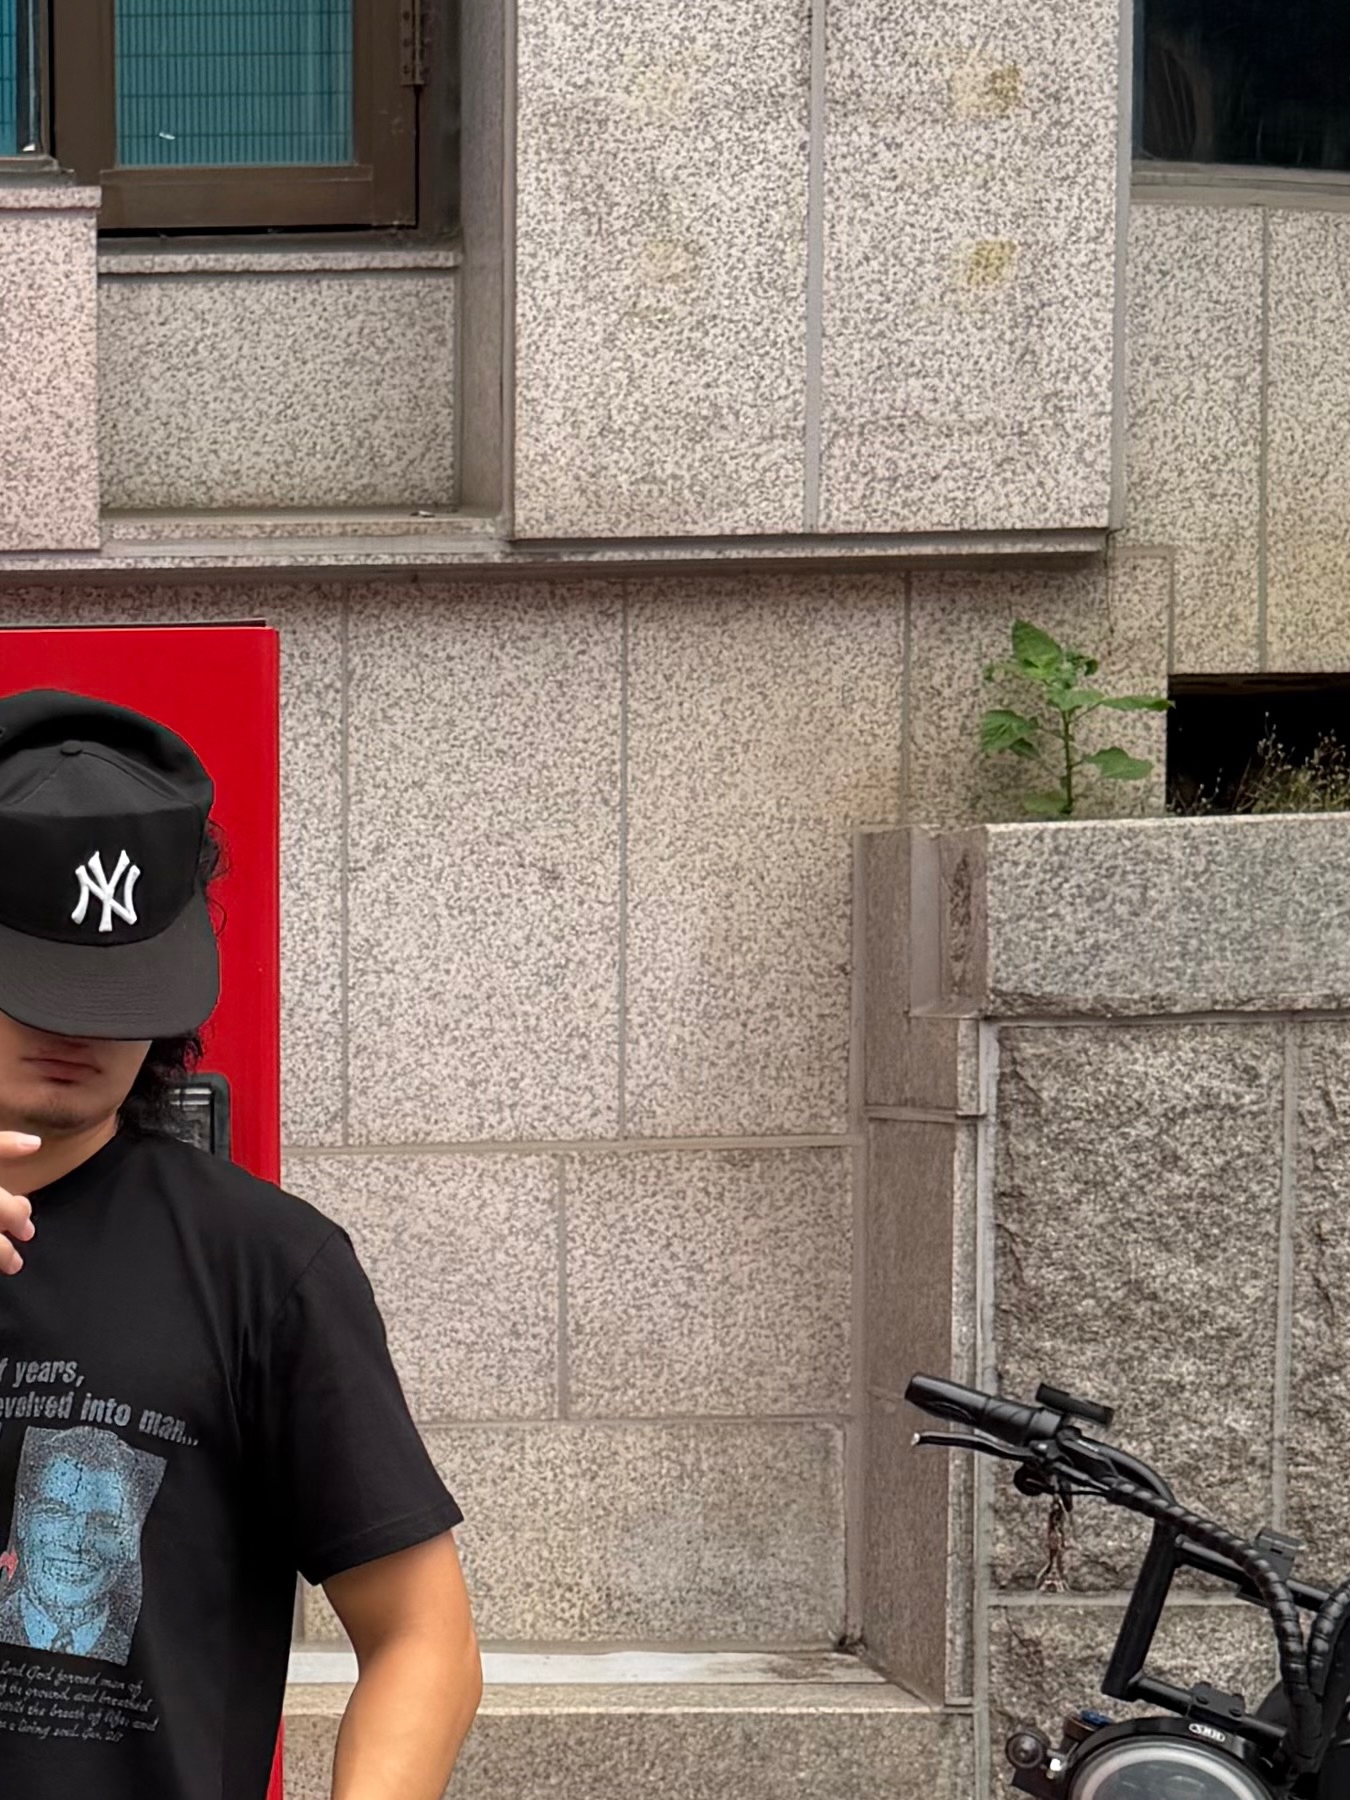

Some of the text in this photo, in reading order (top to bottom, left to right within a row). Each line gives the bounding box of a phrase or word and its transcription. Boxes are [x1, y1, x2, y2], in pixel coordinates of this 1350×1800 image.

[71, 849, 141, 932] NY
[12, 1359, 85, 1388] years,
[80, 1391, 132, 1427] into
[26, 1663, 55, 1681] God
